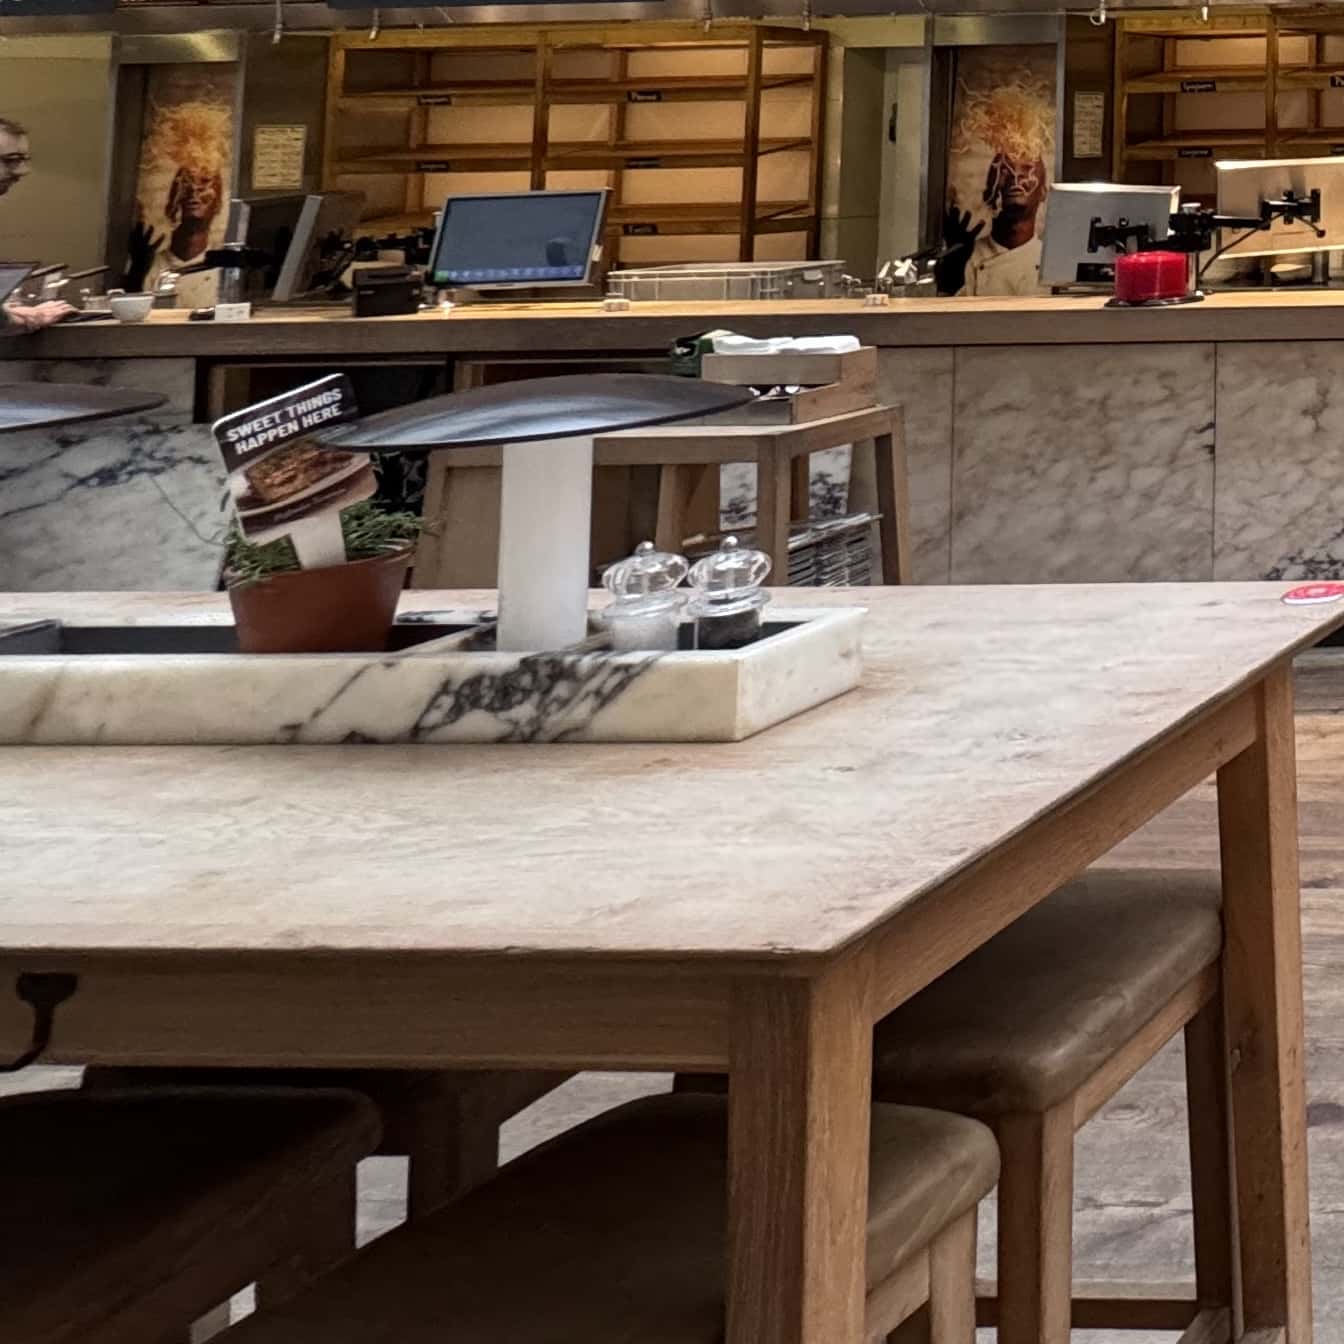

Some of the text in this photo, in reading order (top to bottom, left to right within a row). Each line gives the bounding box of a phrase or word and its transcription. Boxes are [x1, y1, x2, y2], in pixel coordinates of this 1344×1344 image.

[227, 388, 342, 441] SWEET THINGS
[235, 403, 342, 454] HAPPEN HERE
